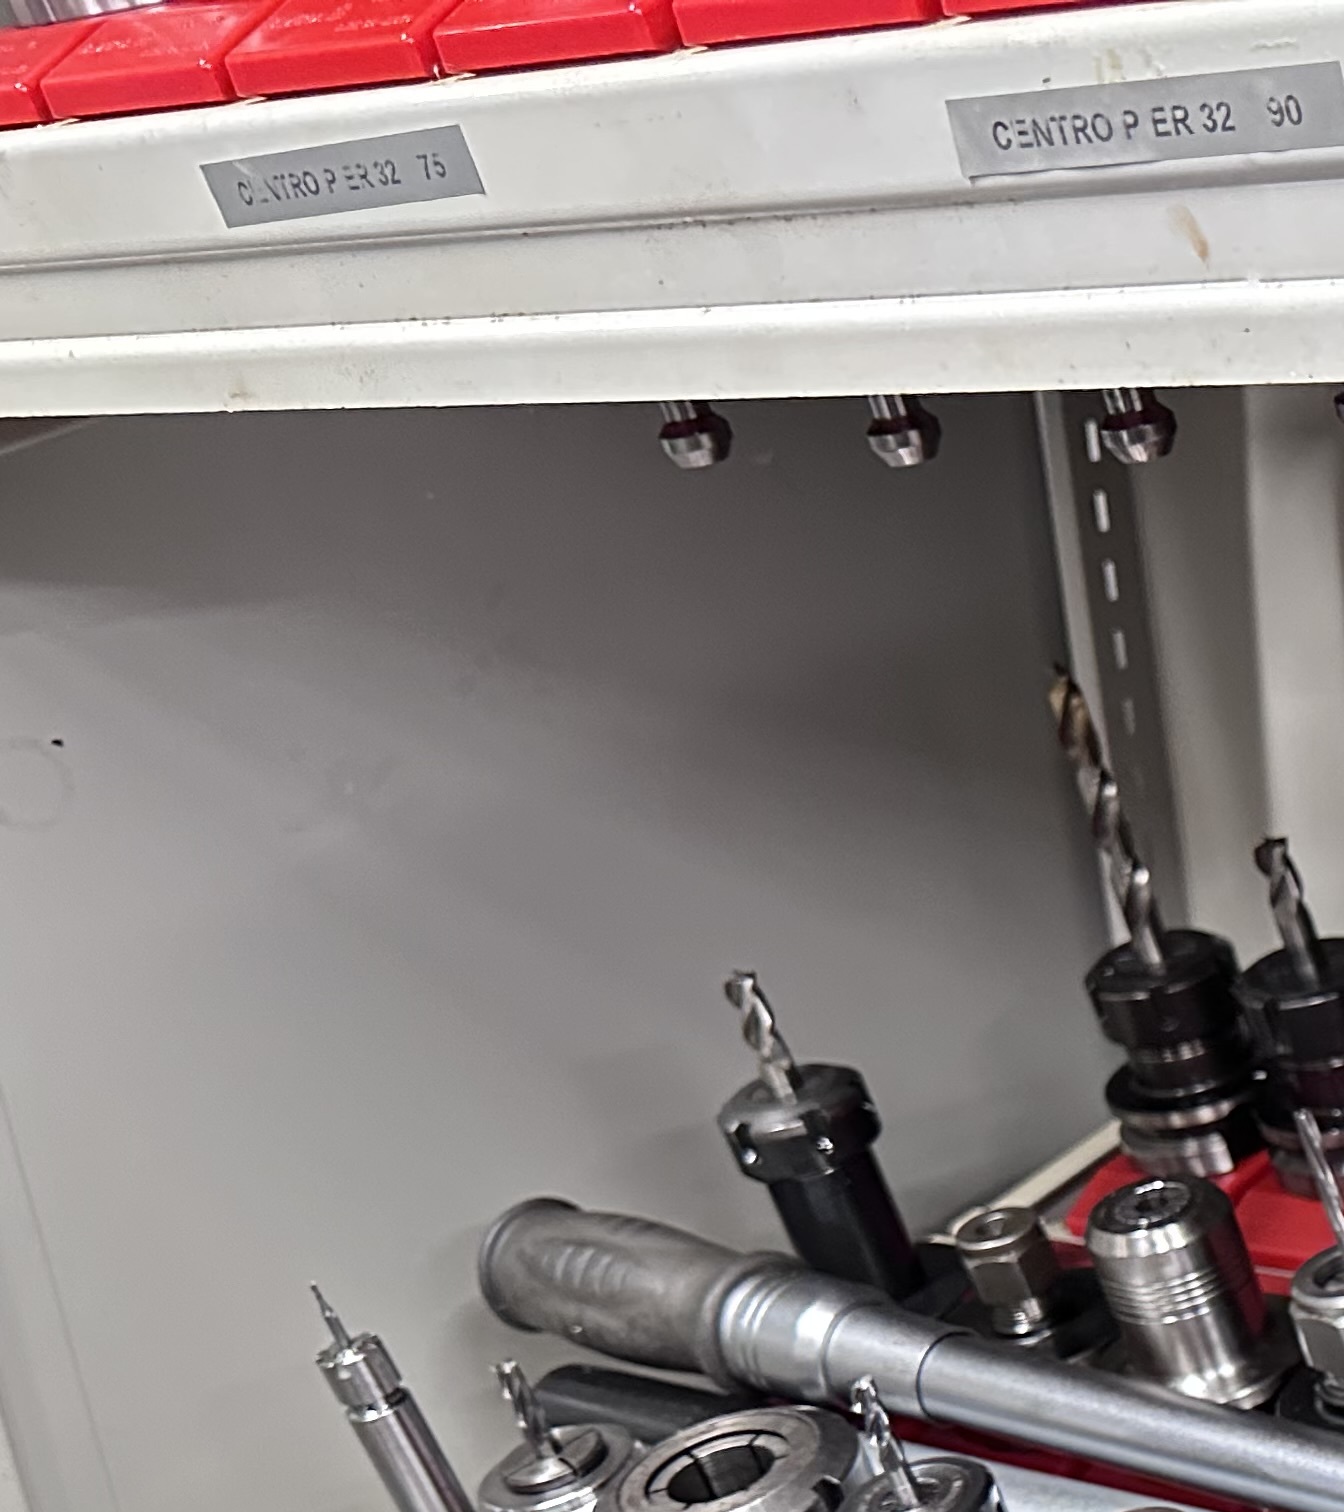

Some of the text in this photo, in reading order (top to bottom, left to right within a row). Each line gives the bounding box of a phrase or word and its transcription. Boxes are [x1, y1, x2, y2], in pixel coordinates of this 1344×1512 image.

[992, 94, 1303, 151] CENTRO P ER 32 90
[323, 168, 336, 194] P
[373, 159, 401, 186] 32
[416, 153, 447, 181] 75
